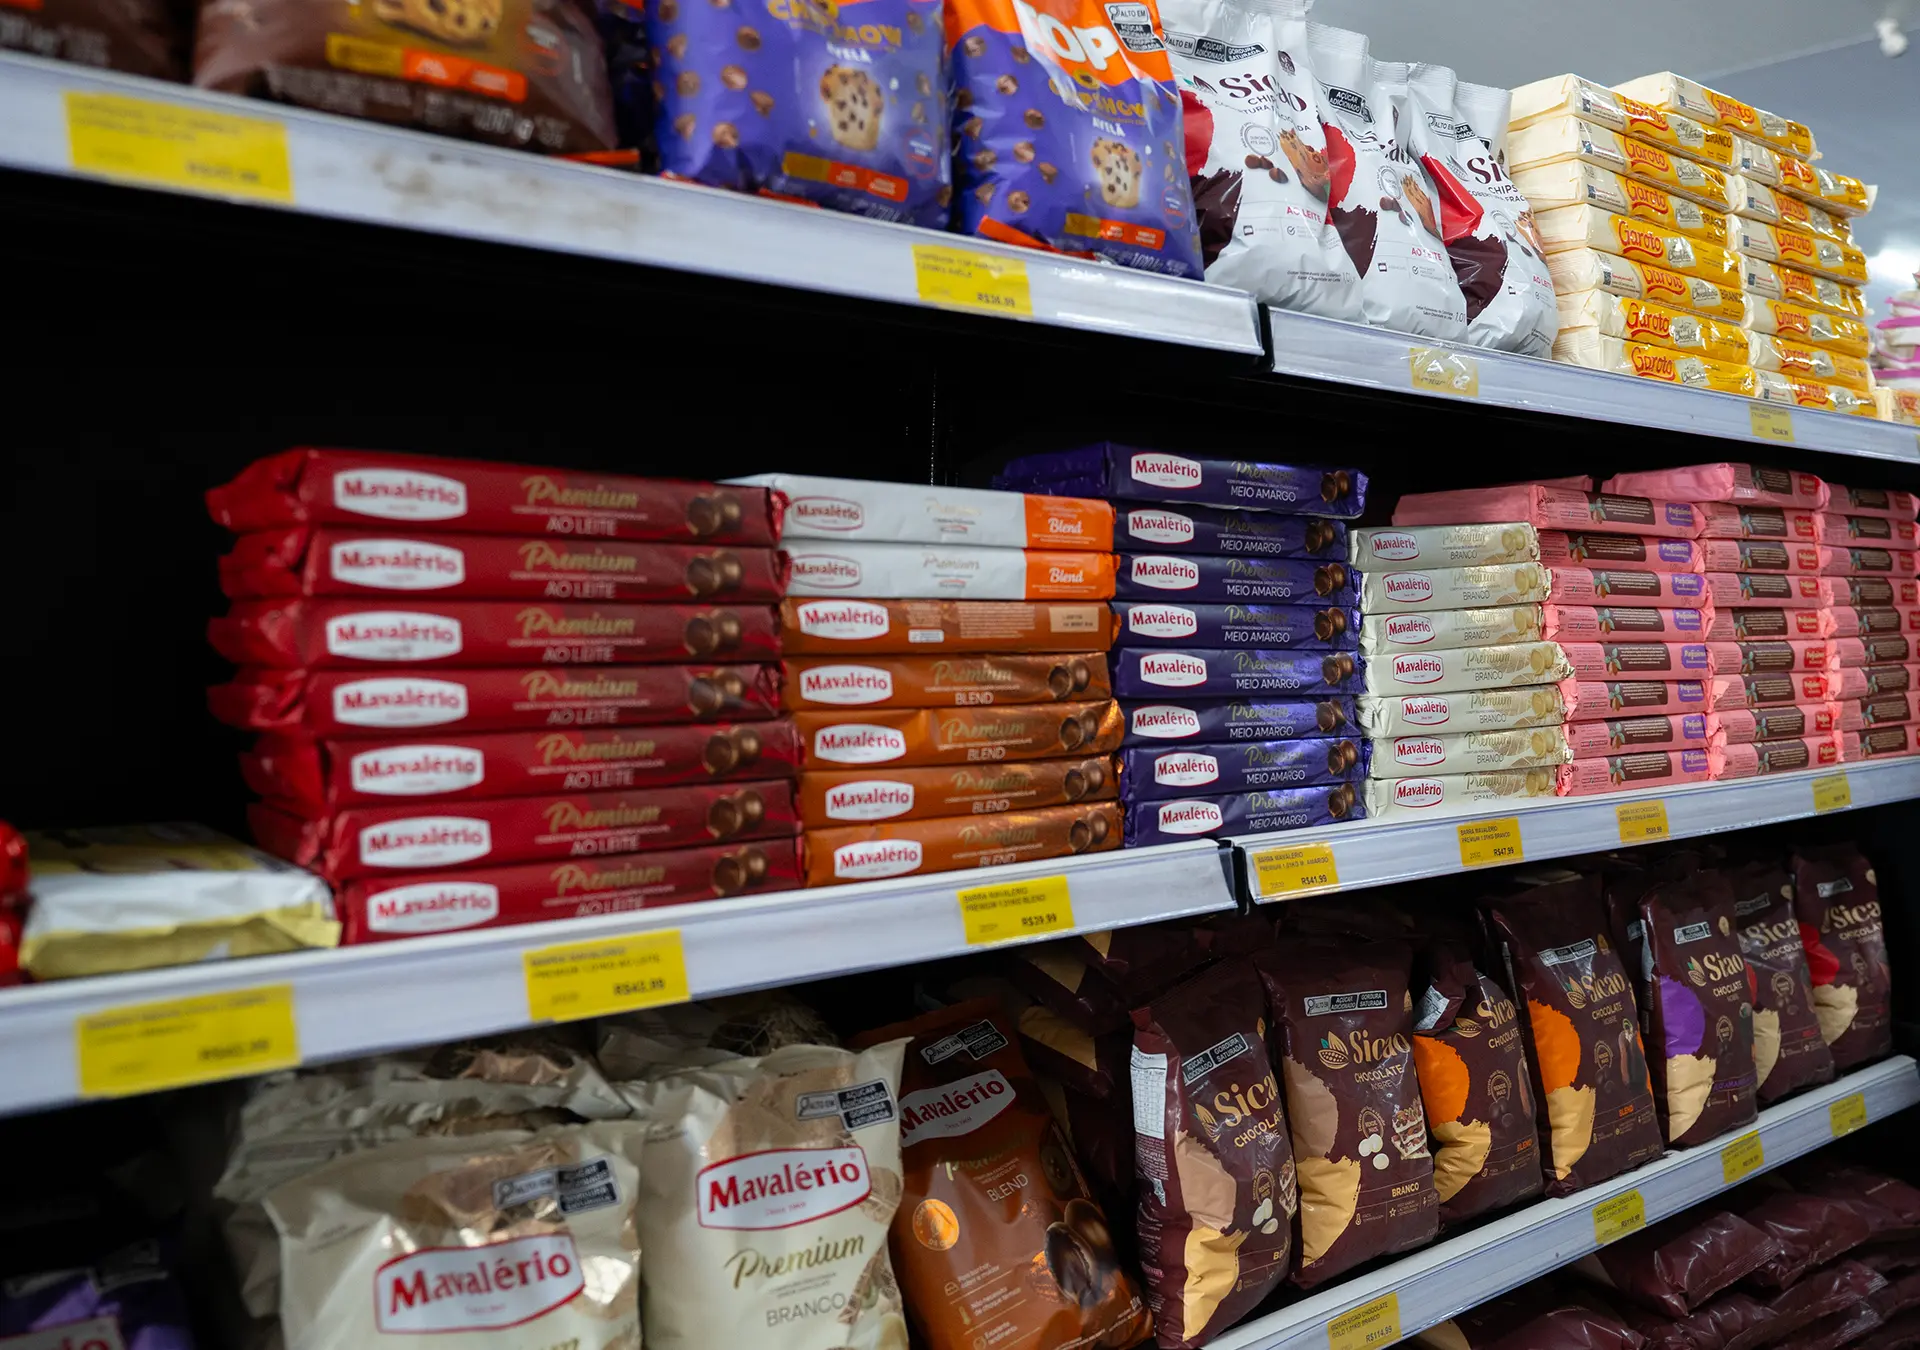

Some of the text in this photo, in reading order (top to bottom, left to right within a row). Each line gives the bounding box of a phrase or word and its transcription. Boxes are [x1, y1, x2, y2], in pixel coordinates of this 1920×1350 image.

[1120, 9, 1146, 18] ALTO EM
[1167, 38, 1194, 49] ALTO EM
[1201, 40, 1223, 51] AÇUCAR
[1227, 45, 1256, 55] GORDURA
[1195, 48, 1226, 62] ADICIONADO
[1228, 49, 1261, 62] SATURADA
[1329, 97, 1361, 113] ADICIONADO
[1336, 90, 1359, 105] AÇUCAR
[1711, 92, 1753, 119] Garoto
[1623, 96, 1668, 125] Garoto
[1434, 121, 1447, 129] ALTO
[1705, 131, 1732, 149] BRANCO
[1624, 135, 1666, 167] Garoto
[1488, 184, 1518, 195] CHIPS
[1626, 179, 1668, 209] Garoto
[1286, 205, 1322, 224] AO LEITE
[1618, 220, 1662, 251] Garoto
[1776, 227, 1812, 253] Garoto
[1411, 247, 1422, 257] AO
[1641, 264, 1684, 289] Garoto
[1626, 302, 1671, 331] Garoto
[1774, 304, 1808, 328] Garoto
[1631, 346, 1674, 375] Garoto
[1134, 458, 1199, 479] Mavalério
[343, 478, 460, 505] Mavalério
[521, 475, 638, 509] Premium
[1230, 485, 1296, 502] MEIO AMARGO
[797, 505, 860, 522] Mavalério
[547, 517, 617, 536] AO LEITE
[1048, 517, 1083, 534] Blend
[1131, 514, 1191, 534] Mavalério
[1220, 539, 1282, 554] MEIO AMARGO
[1450, 551, 1477, 560] BRANCO
[340, 550, 457, 575] Mavalério
[518, 541, 636, 571] Premium
[1049, 567, 1084, 584] Blend
[1134, 561, 1196, 579] Mavalério
[545, 580, 616, 598] AO LEITE
[1227, 584, 1291, 598] MEIO AMARGO
[1386, 578, 1430, 593] Mavalério
[1463, 590, 1490, 600] BRANCO
[516, 607, 635, 638] Premium
[804, 607, 884, 628] Mavalério
[1131, 610, 1194, 627] Mavalério
[1388, 619, 1431, 634] Mavalério
[337, 621, 454, 643] Mavalério
[1224, 631, 1290, 643] MEIO AMARGO
[1464, 630, 1490, 641] BRANCO
[542, 646, 615, 662] AO LEITE
[1464, 650, 1511, 666] Premium
[932, 660, 1012, 686] Premium
[1143, 659, 1204, 676] Mavalério
[1395, 658, 1441, 674] Mavalério
[521, 670, 638, 700] Premium
[805, 673, 888, 693] Mavalério
[1236, 677, 1300, 689] MEIO AMARGO
[1475, 671, 1503, 681] BRANCO
[343, 687, 460, 711] Mavalério
[955, 692, 994, 705] BLEND
[1470, 691, 1511, 708] Premium
[547, 707, 620, 724] AO LEITE
[1228, 702, 1289, 721] Premium
[1404, 701, 1447, 716] Mavalério
[1134, 711, 1196, 727] Mavalério
[1479, 713, 1506, 723] BRANCO
[941, 717, 1026, 744] Premium
[1229, 725, 1294, 738] MEIO AMARGO
[819, 731, 900, 750] Mavalério
[1396, 741, 1443, 755] Mavalério
[1464, 731, 1511, 749] Premium
[536, 734, 655, 766] Premium
[967, 747, 1005, 761] BLEND
[1244, 745, 1305, 767] Premium
[1476, 754, 1504, 764] BRANCO
[360, 754, 476, 781] Mavalério
[1156, 757, 1215, 775] Mavalério
[563, 769, 635, 789] AO LEITE
[950, 769, 1030, 797] Premium
[1246, 769, 1305, 784] MEIO AMARGO
[1464, 771, 1507, 789] Premium
[1395, 781, 1441, 799] Mavalério
[831, 788, 910, 811] Mavalério
[972, 799, 1010, 813] BLEND
[1247, 791, 1305, 812] Premium
[543, 802, 661, 834] Premium
[1161, 806, 1219, 826] Mavalério
[1249, 814, 1307, 829] MEIO AMARGO
[959, 824, 1037, 849] Premium
[1460, 825, 1498, 836] BARRA MAVALERIO
[1494, 831, 1511, 839] BRANCO
[368, 826, 483, 854] Mavalério
[570, 835, 641, 855] AO LEITE
[840, 845, 918, 869] Mavalério
[1274, 851, 1304, 861] MAVALERIO
[1493, 846, 1514, 856] R$47.99
[1306, 856, 1329, 865] AMARGO
[552, 864, 666, 897] Premium
[1300, 874, 1328, 886] R$41.99
[376, 892, 492, 919] Mavalério
[576, 899, 603, 917] AO
[1830, 900, 1881, 930] Sica
[1746, 917, 1799, 947] Sica
[1580, 971, 1625, 1003] Sicao
[1476, 995, 1517, 1029] Sica
[1591, 1001, 1623, 1021] CHOCOLATE
[1214, 1037, 1240, 1055] GORDURA
[1349, 1029, 1411, 1064] Sicao
[1488, 1026, 1519, 1049] CHOCOLATE
[1216, 1043, 1243, 1063] SATURADA
[1354, 1064, 1403, 1083] CHOCOLATE
[1370, 1079, 1393, 1091] NOBRE
[1213, 1069, 1279, 1127] Sica
[900, 1080, 1005, 1139] Mavalério
[1618, 1104, 1634, 1118] BLEND
[1516, 1138, 1533, 1152] BLEND
[708, 1159, 860, 1214] Mavalério
[986, 1173, 1029, 1202] BLEND
[1391, 1182, 1420, 1198] BRANCO
[724, 1234, 865, 1290] Premium
[389, 1250, 571, 1316] Mavalério
[766, 1291, 846, 1327] BRANCO
[1347, 1313, 1362, 1324] SICAO
[1361, 1301, 1388, 1317] CHOCOLATE
[1331, 1313, 1381, 1339] GOLD BRANCO
